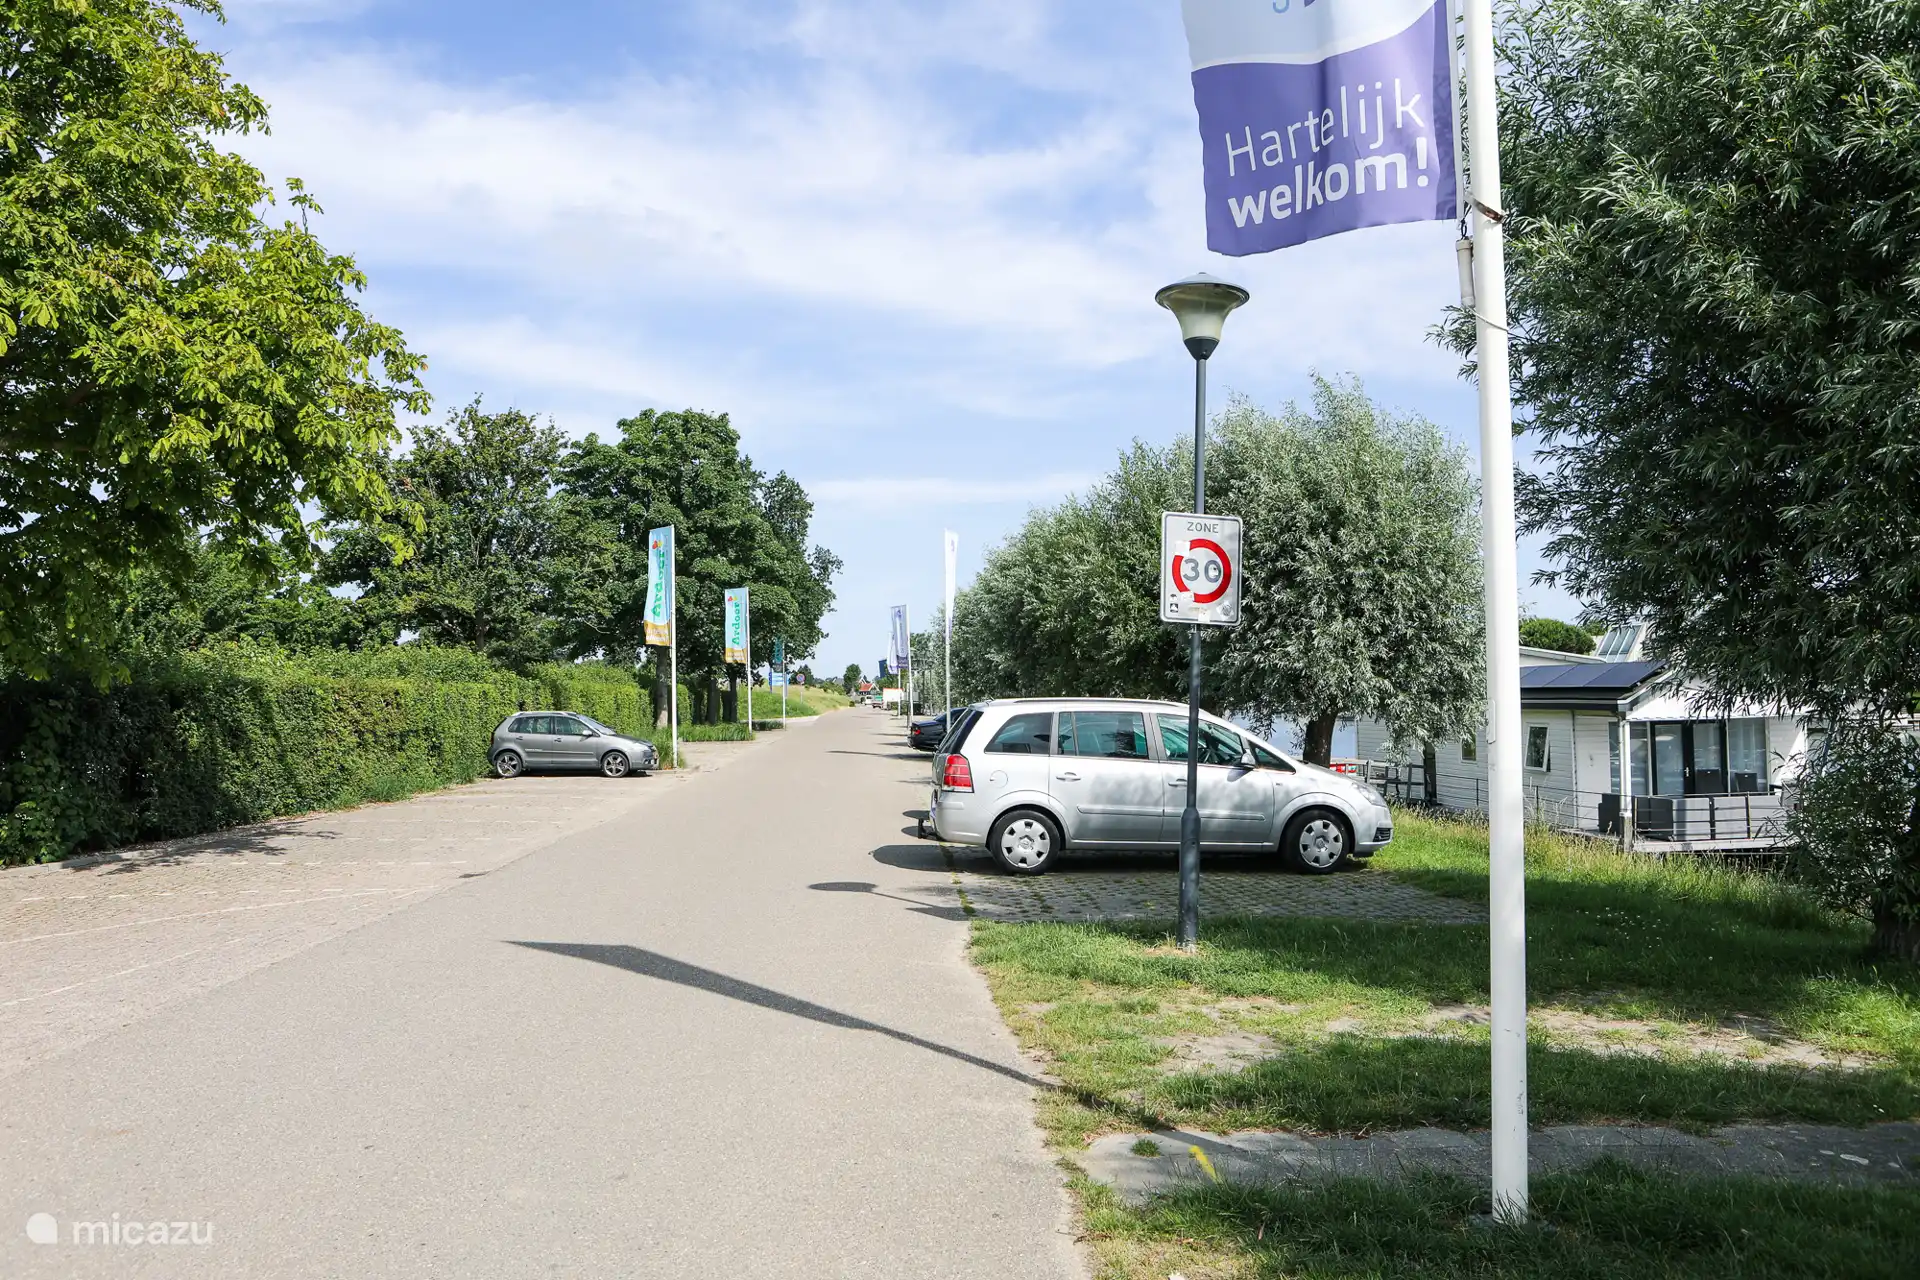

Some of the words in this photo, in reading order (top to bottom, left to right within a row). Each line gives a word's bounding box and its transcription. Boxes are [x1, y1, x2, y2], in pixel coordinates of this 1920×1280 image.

[1225, 78, 1424, 177] Hartelijk
[1228, 136, 1428, 228] welkom!
[1187, 522, 1219, 533] ZONE
[1183, 558, 1221, 583] 30
